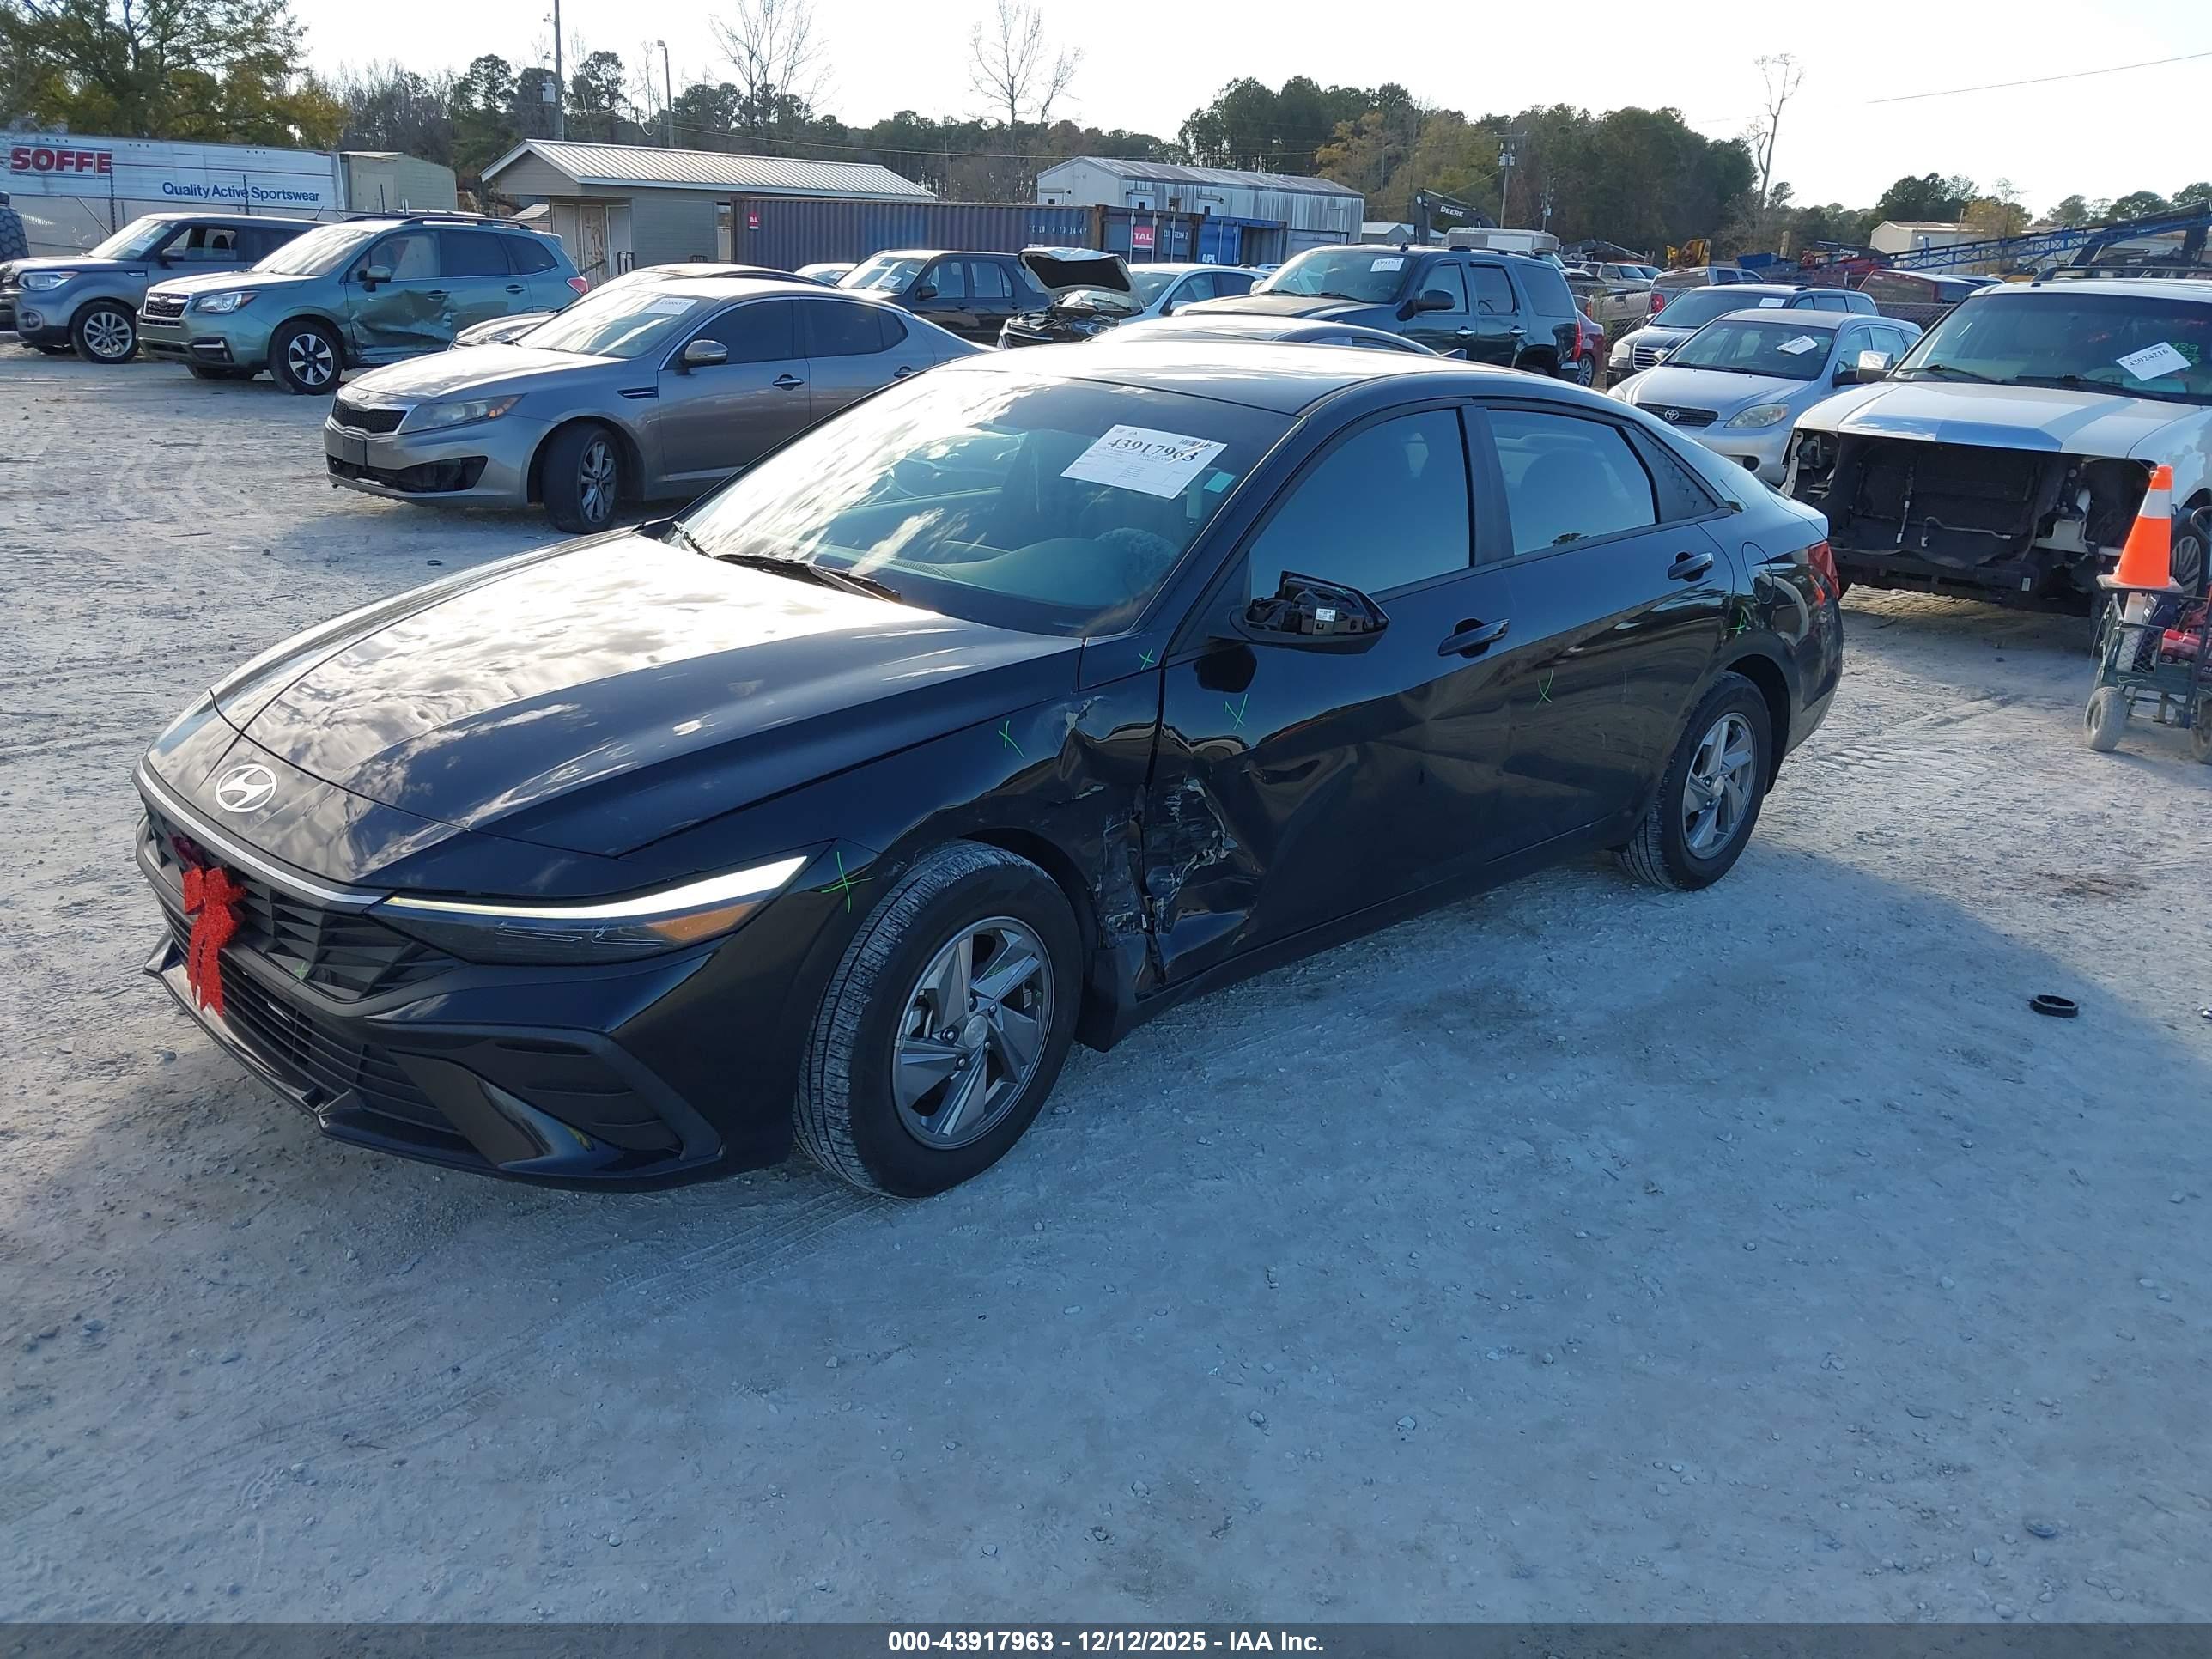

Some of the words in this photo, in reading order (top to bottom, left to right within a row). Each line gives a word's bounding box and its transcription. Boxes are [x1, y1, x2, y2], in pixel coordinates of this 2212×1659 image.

[11, 147, 112, 173] SOFFE
[162, 182, 210, 198] Quality
[212, 185, 248, 198] Active
[251, 186, 319, 202] Sportswear
[1440, 206, 1464, 217] DEERE
[1202, 254, 1216, 263] APL
[2130, 349, 2168, 366] 43924216
[1108, 438, 1199, 461] 43917963
